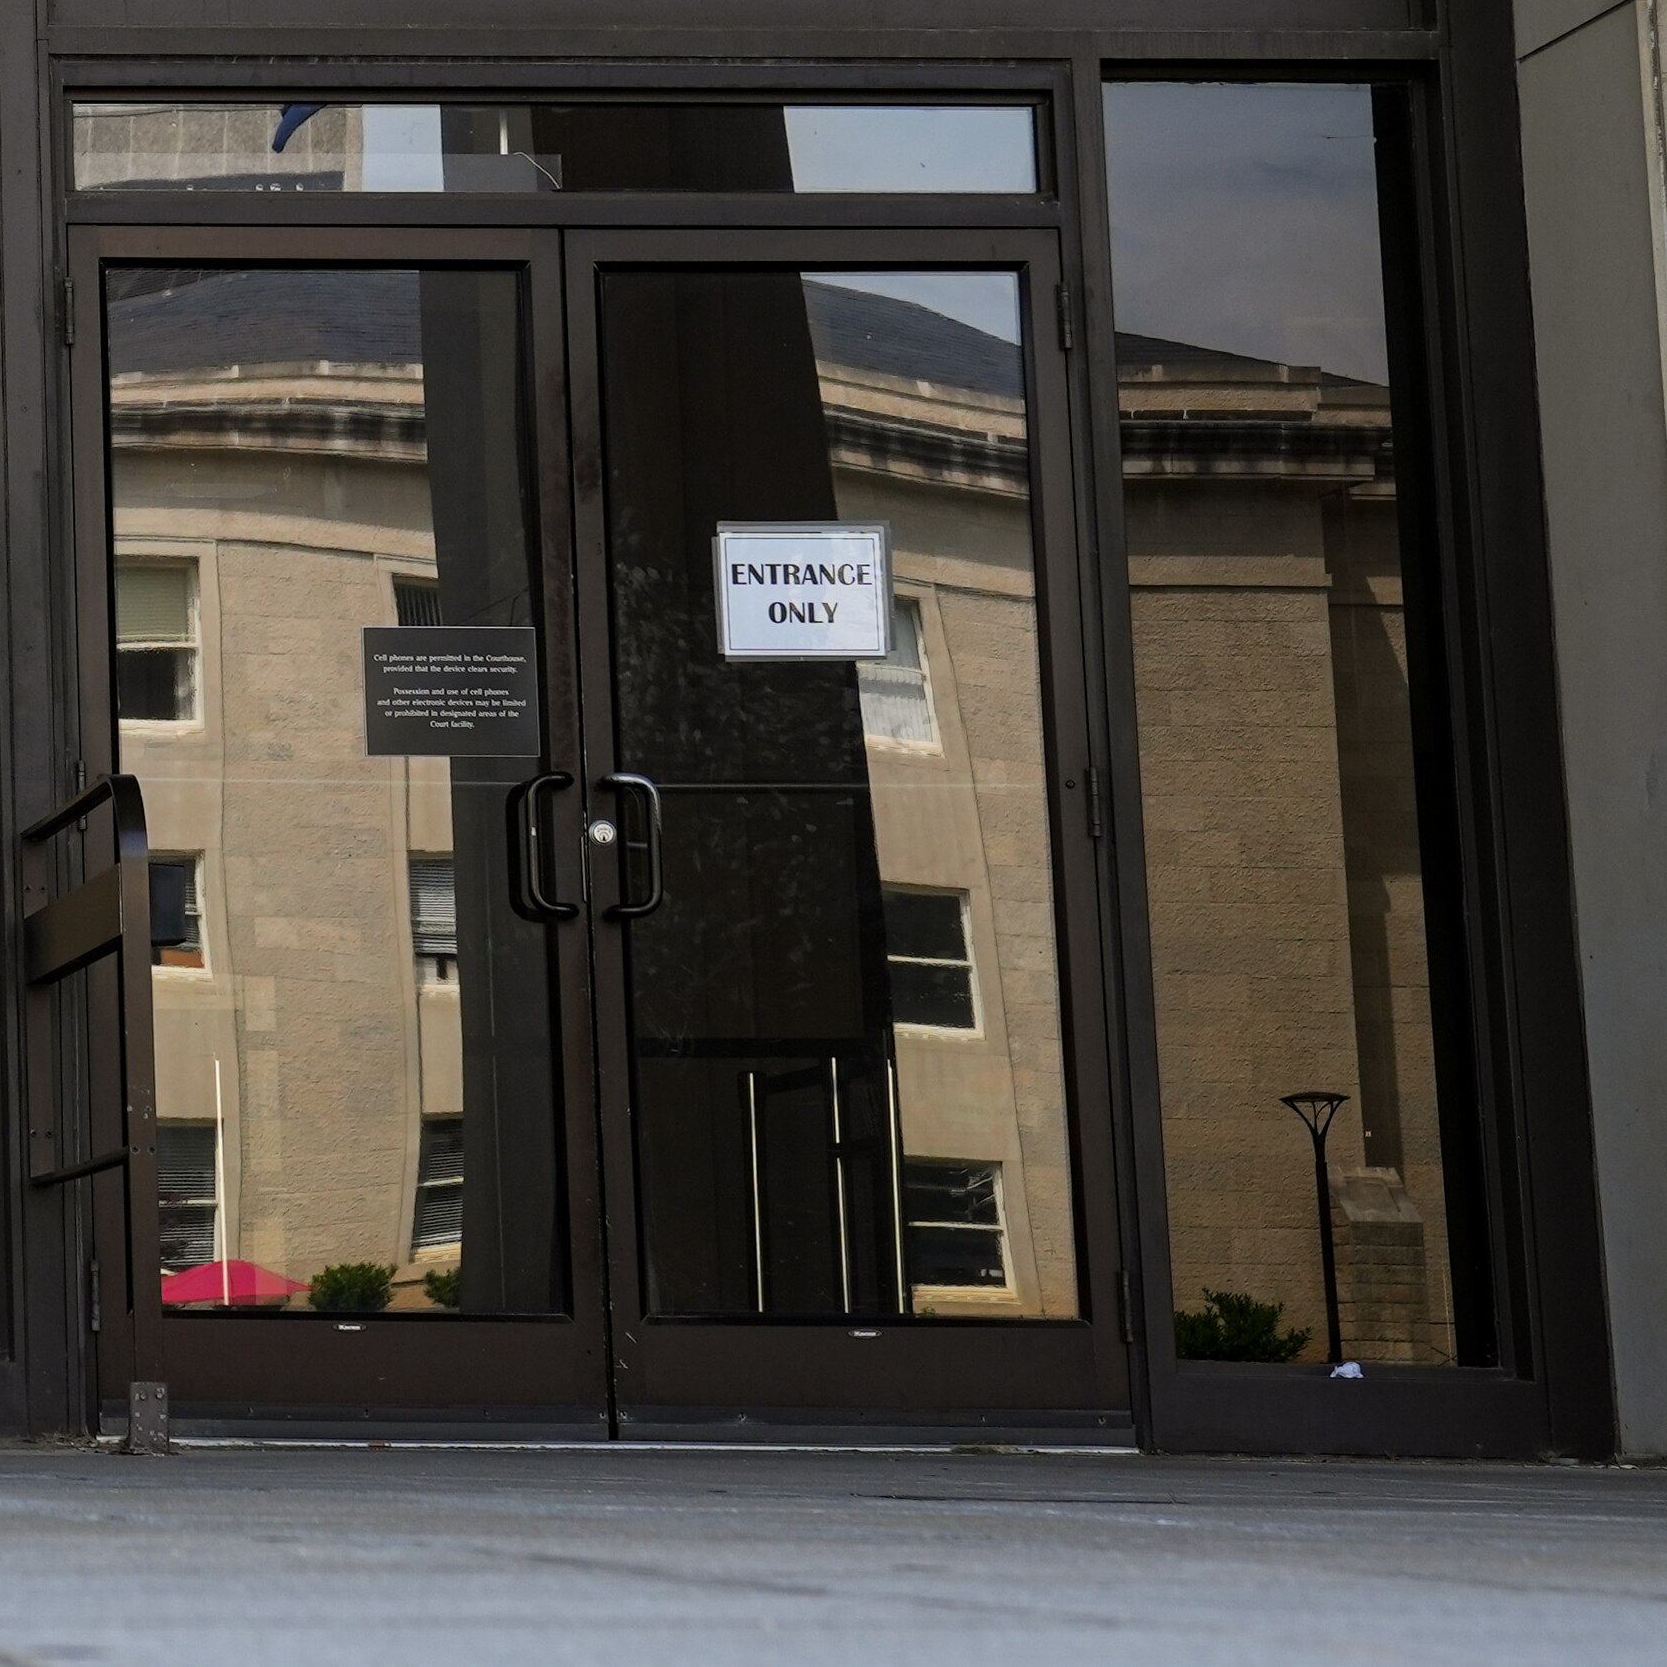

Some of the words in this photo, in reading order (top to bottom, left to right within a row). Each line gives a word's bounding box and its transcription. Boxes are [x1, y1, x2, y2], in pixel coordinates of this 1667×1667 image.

[731, 563, 873, 585] ENTRANCE
[768, 602, 838, 624] ONLY
[377, 698, 391, 706] and
